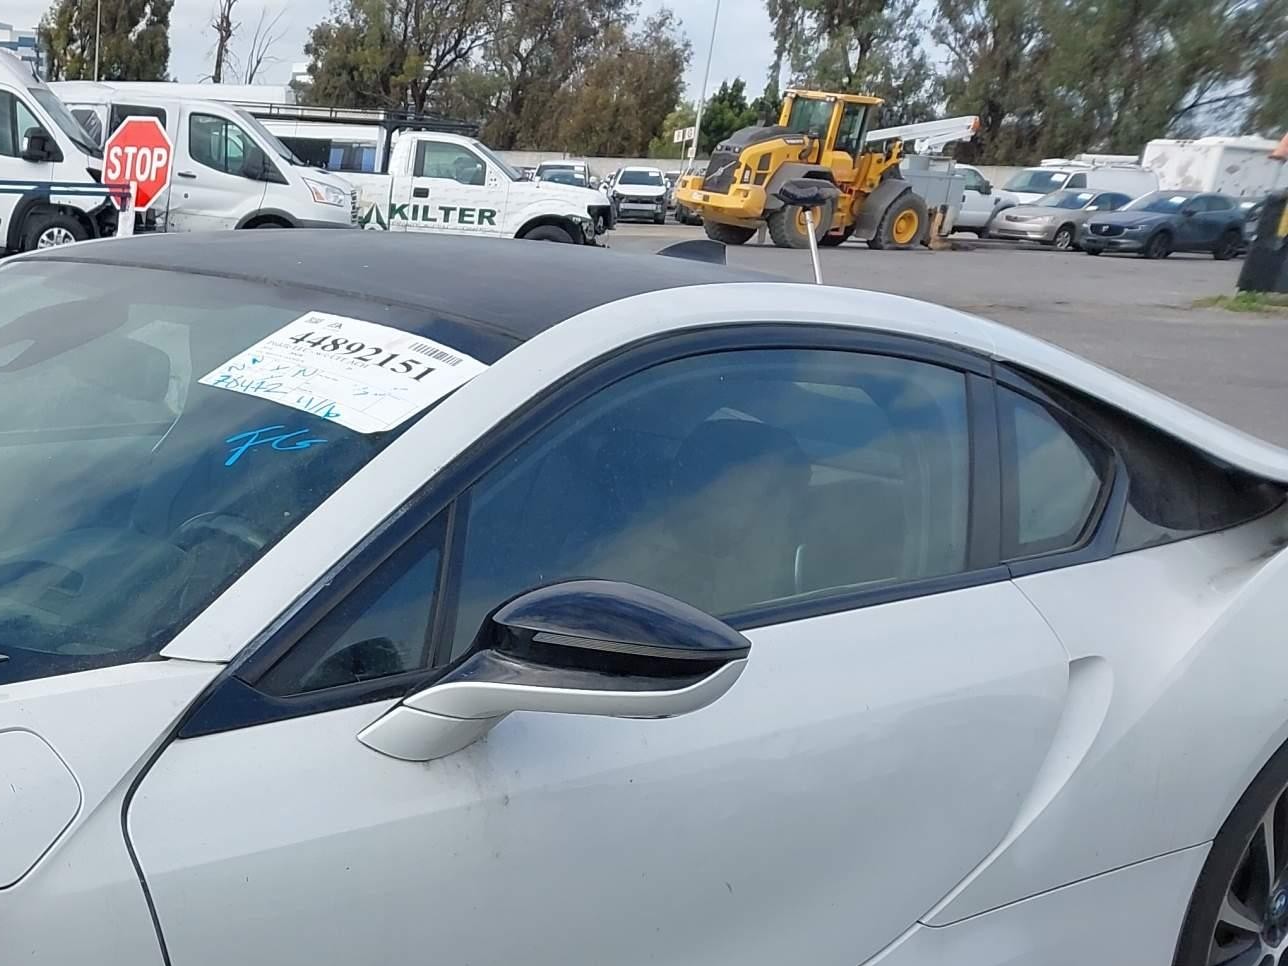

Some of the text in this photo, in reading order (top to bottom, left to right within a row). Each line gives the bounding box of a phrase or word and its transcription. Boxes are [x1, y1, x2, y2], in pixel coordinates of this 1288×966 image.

[107, 146, 168, 181] STOP
[390, 202, 497, 226] KILTER
[289, 331, 437, 382] 44892151
